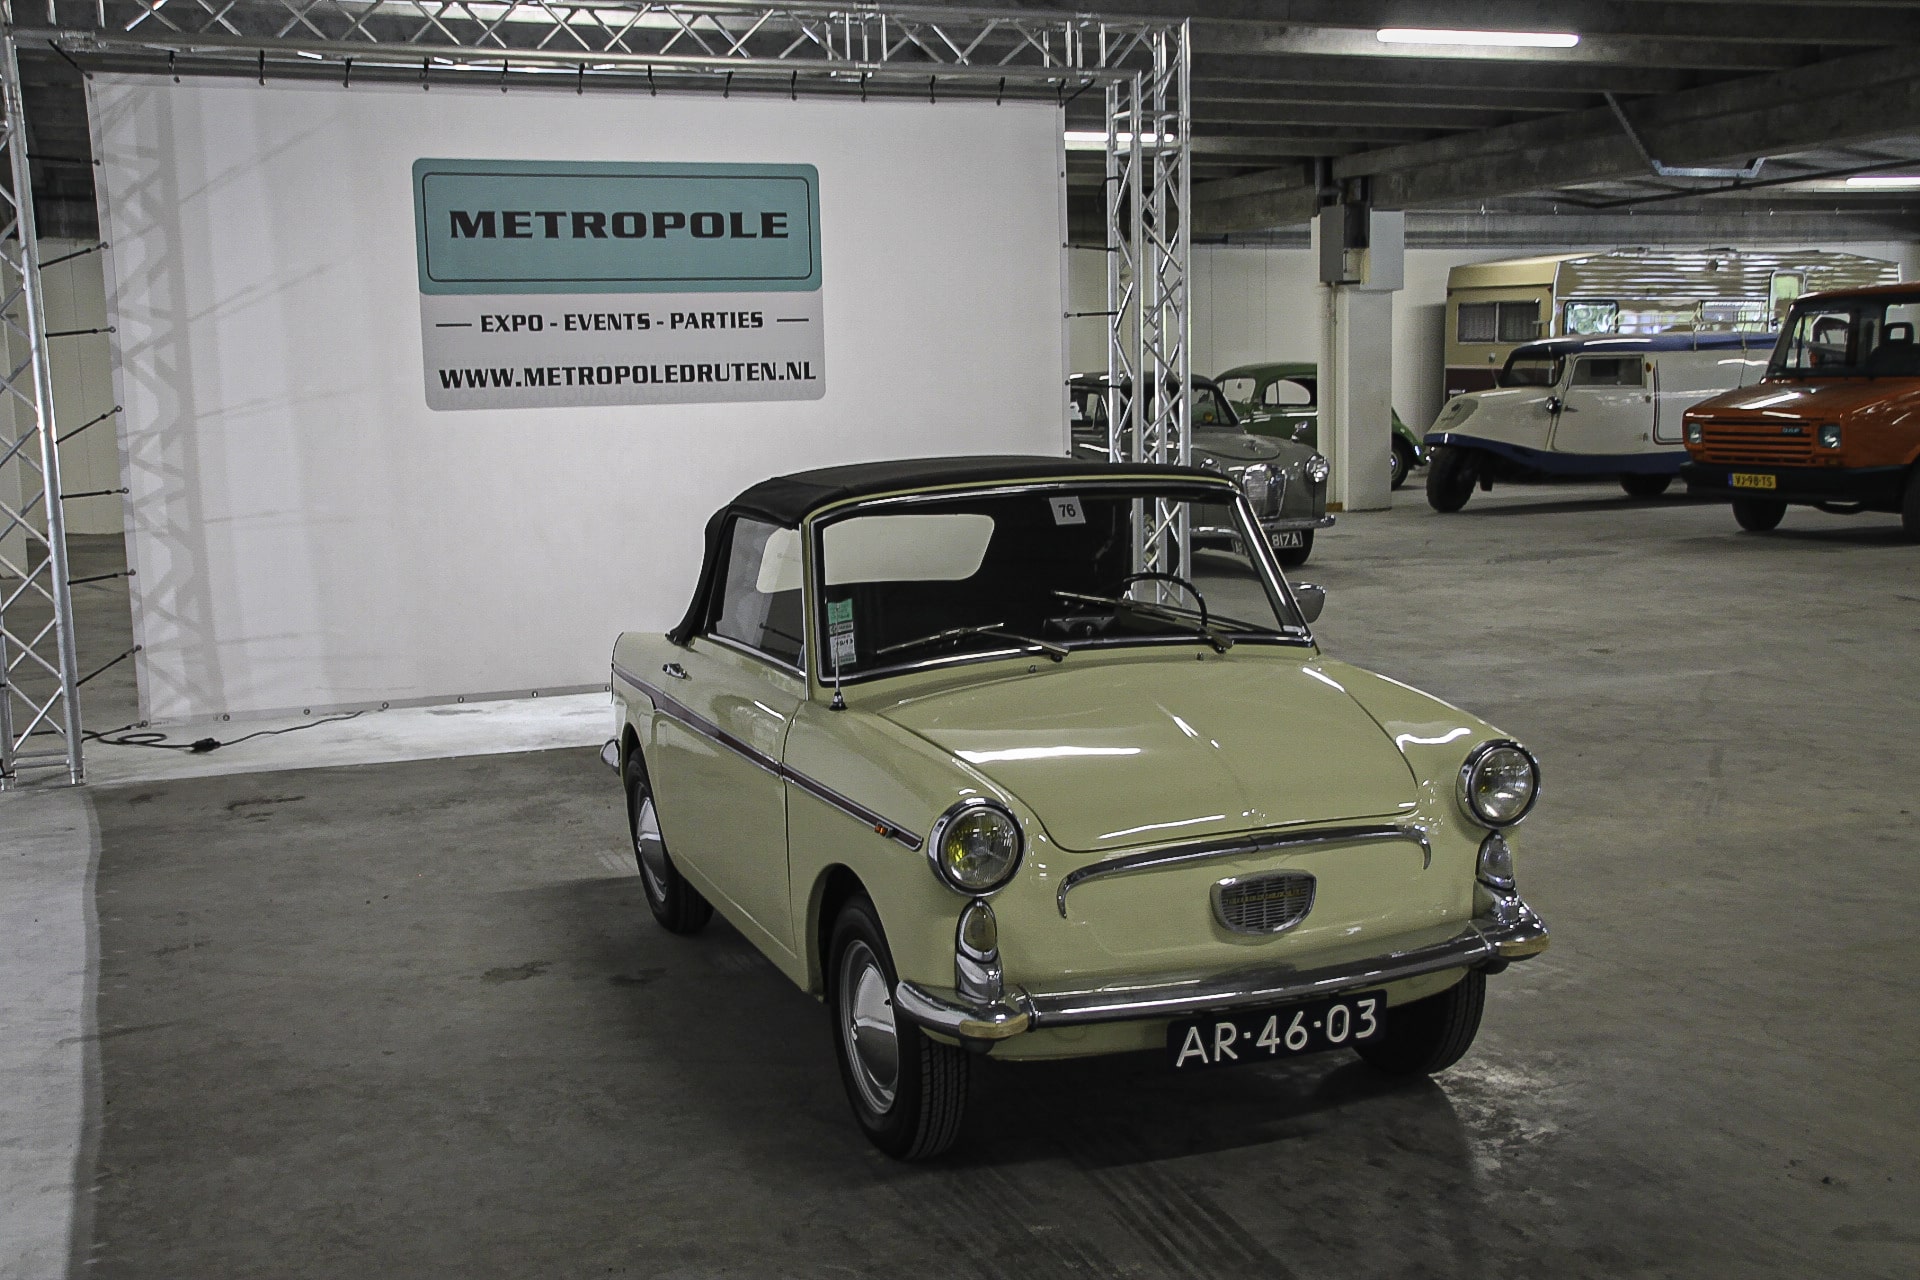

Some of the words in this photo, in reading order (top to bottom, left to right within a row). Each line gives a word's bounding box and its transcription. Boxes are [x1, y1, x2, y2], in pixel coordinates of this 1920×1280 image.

[449, 210, 788, 239] METROPOLE
[481, 314, 543, 333] EXPO
[564, 312, 651, 330] EVENTS
[671, 311, 763, 329] PARTIES
[439, 361, 816, 388] WWW.METROPOLEDRUTEN.NL
[1058, 503, 1076, 518] 76
[1176, 999, 1377, 1067] AR-46-03
